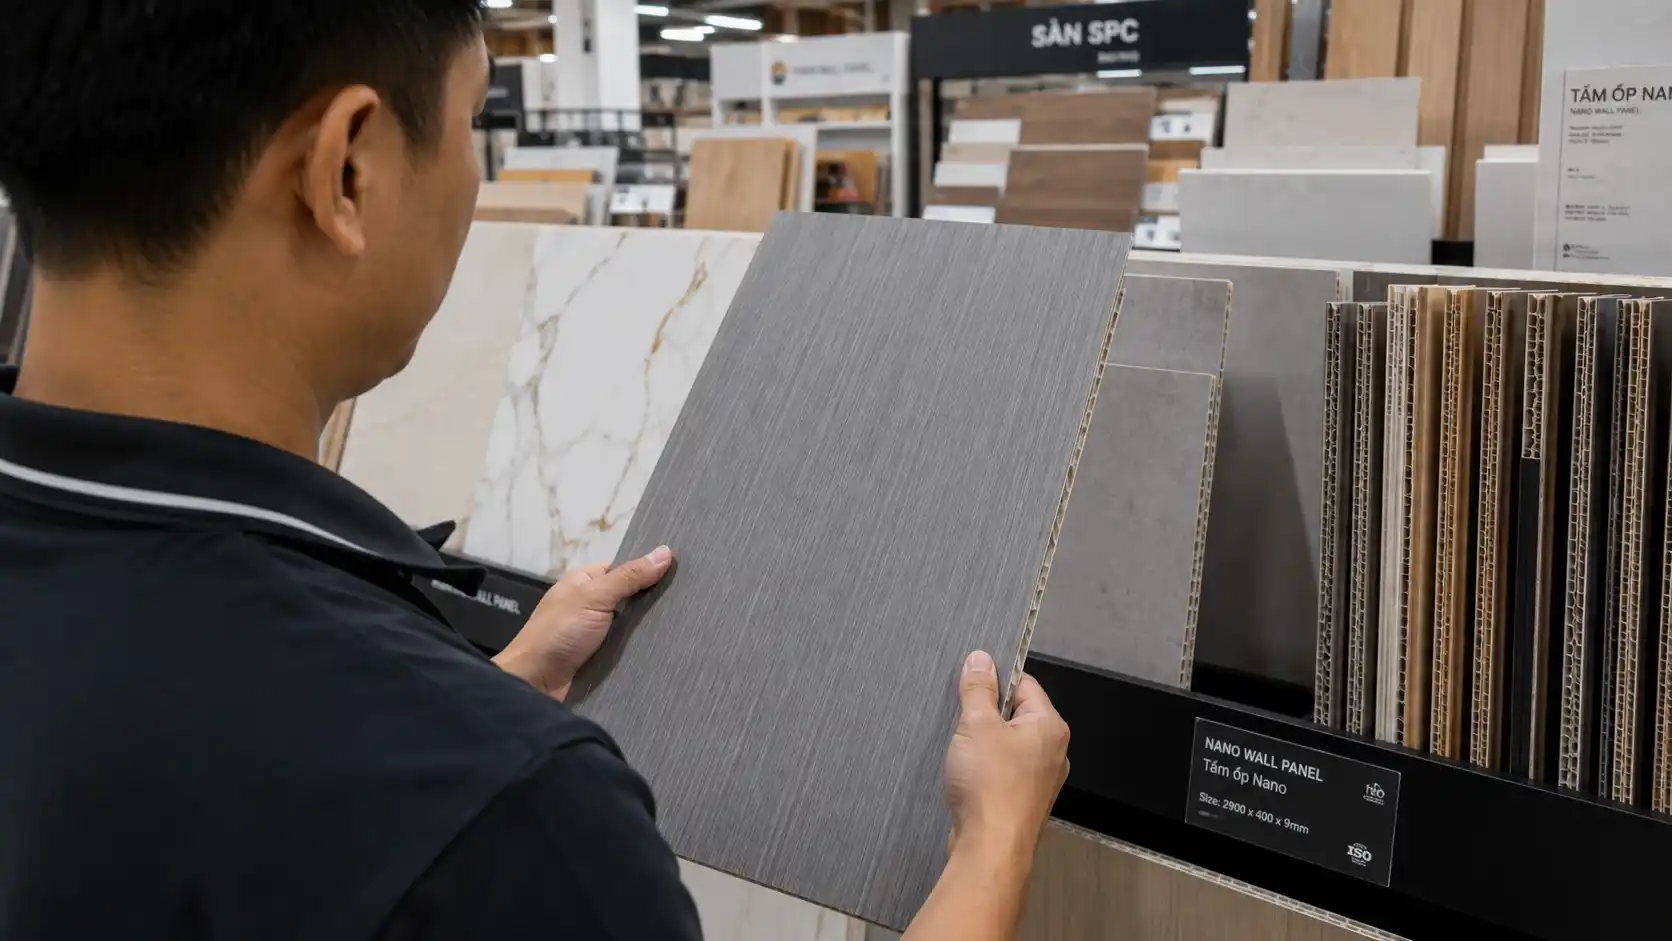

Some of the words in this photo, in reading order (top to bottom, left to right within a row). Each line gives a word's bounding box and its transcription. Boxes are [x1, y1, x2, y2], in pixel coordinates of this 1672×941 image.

[1087, 17, 1140, 45] SPC
[1205, 736, 1241, 757] NANO
[1243, 747, 1279, 769] WALL
[1281, 758, 1324, 782] PANEL
[1252, 772, 1288, 795] Nano
[1199, 791, 1221, 807] Size:
[1222, 799, 1247, 814] 2900
[1247, 808, 1254, 817] x
[1255, 810, 1274, 823] 400
[1274, 816, 1282, 826] x
[1283, 818, 1310, 834] 9mm
[1347, 844, 1372, 861] ISO
